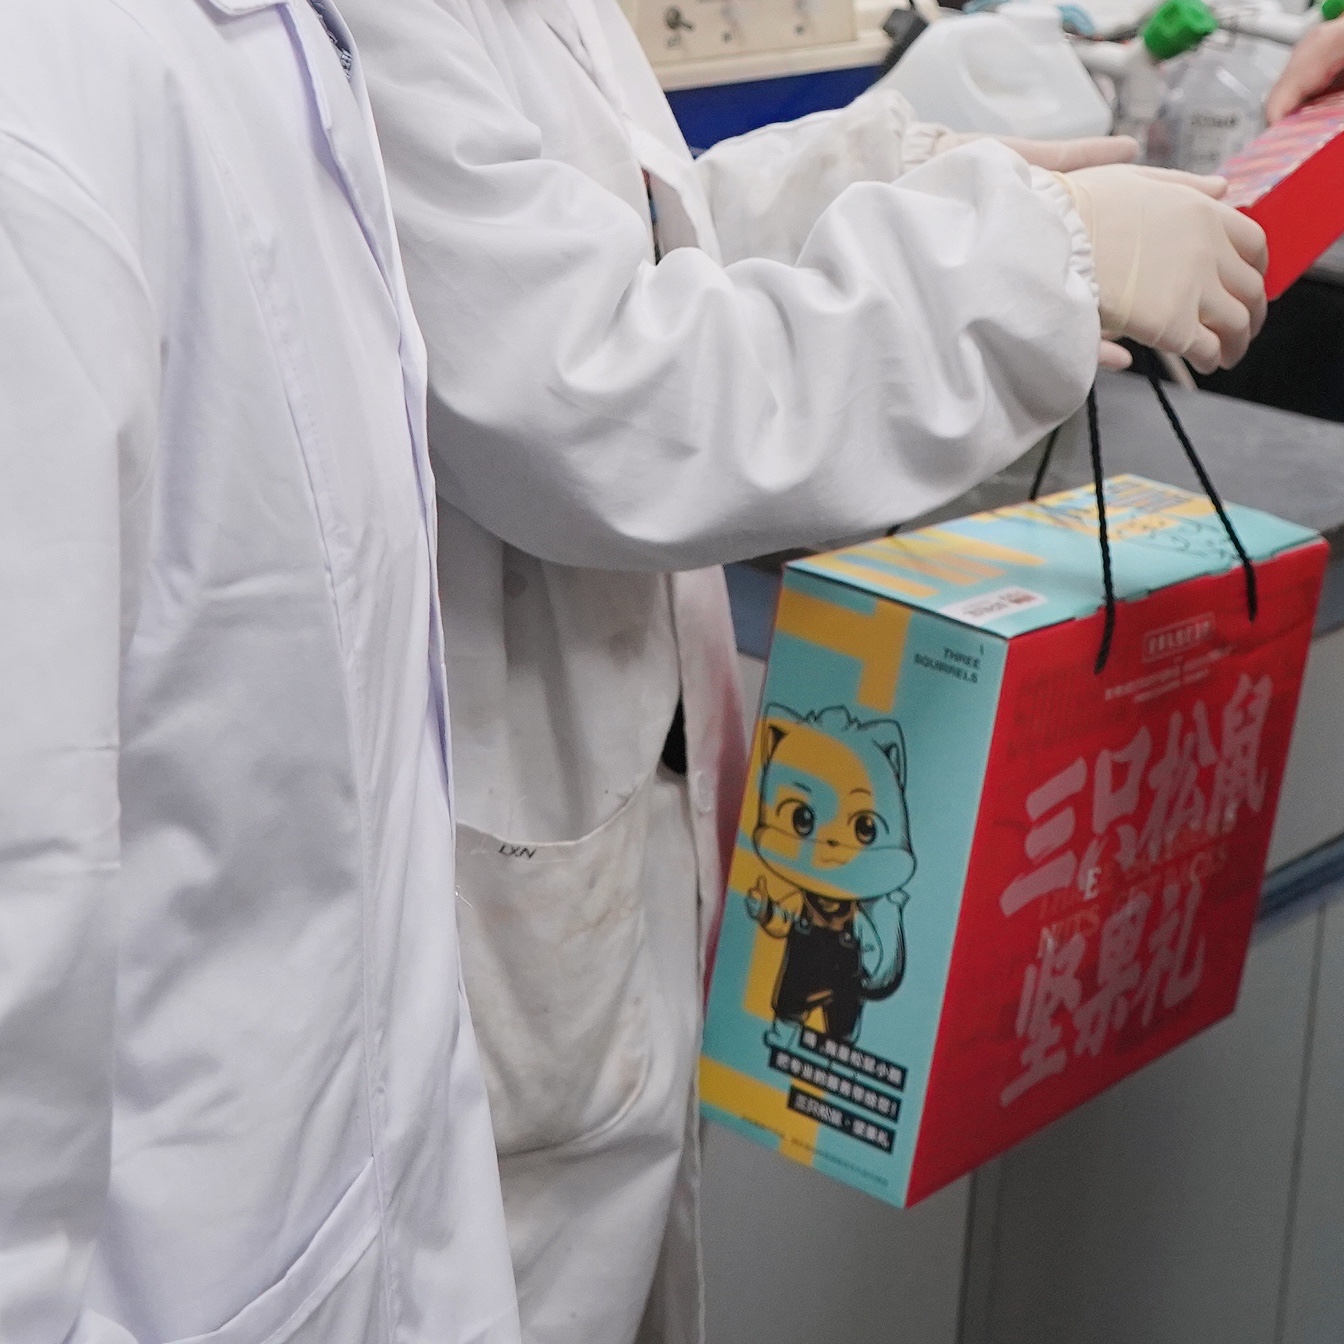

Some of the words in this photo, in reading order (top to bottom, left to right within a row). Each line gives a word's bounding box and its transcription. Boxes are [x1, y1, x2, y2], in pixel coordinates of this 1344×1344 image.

[997, 672, 1274, 918] 三只松鼠
[999, 880, 1208, 1109] 坚果礼
